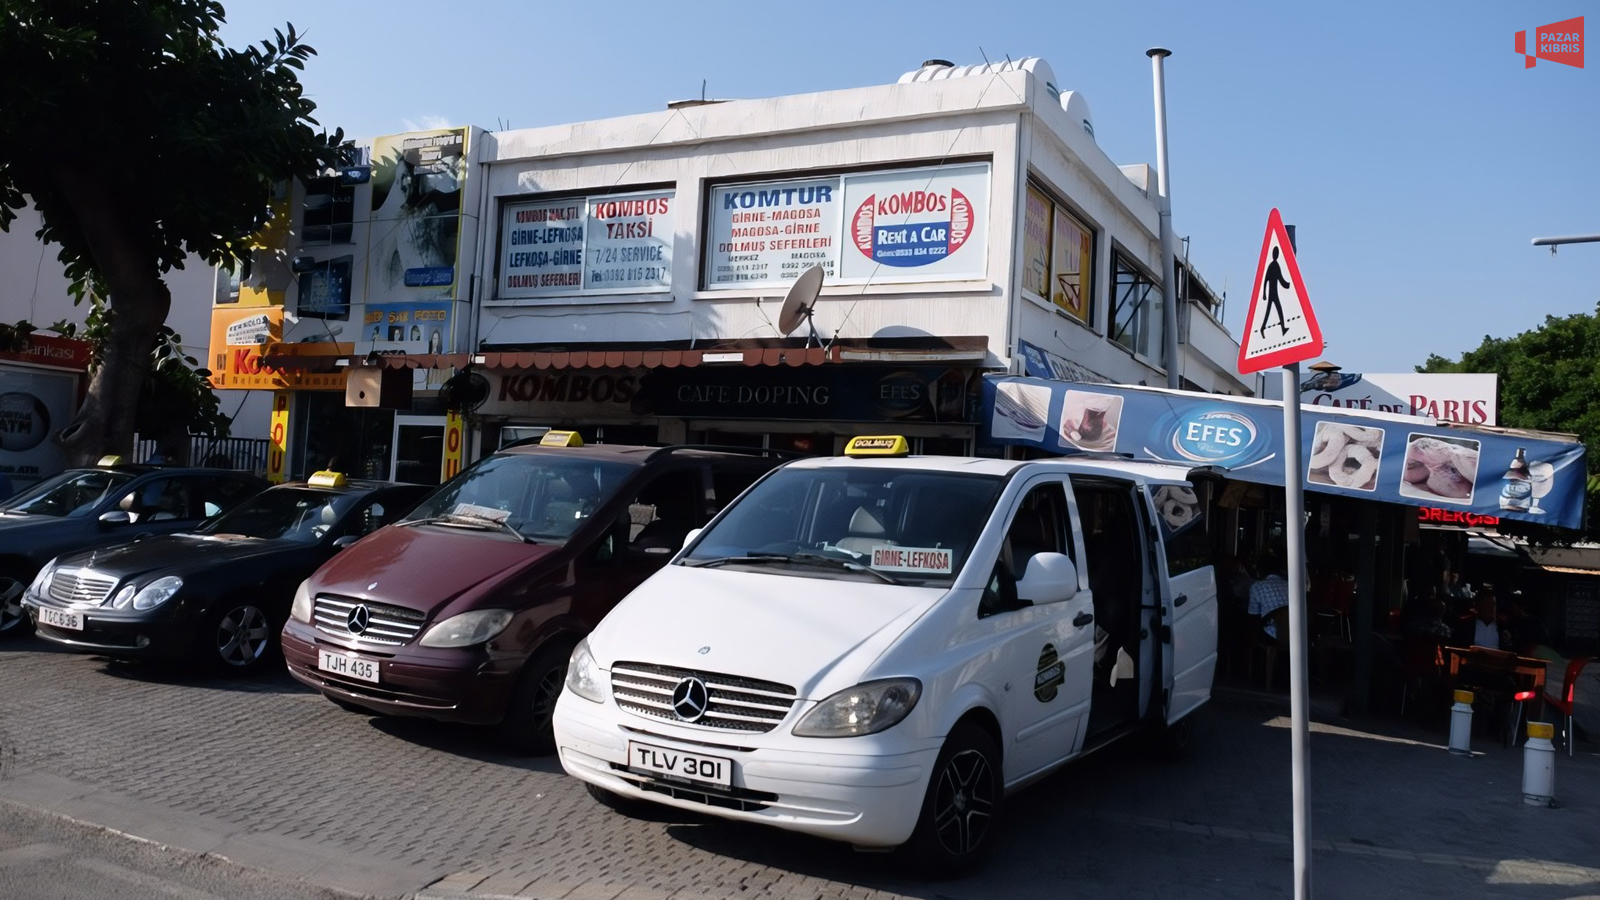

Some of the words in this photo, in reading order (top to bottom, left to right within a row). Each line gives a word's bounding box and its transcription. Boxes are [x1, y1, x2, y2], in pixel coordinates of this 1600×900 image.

[596, 197, 669, 219] KOMBOS
[724, 185, 832, 210] KOMTUR
[878, 190, 947, 216] KOMBOS
[606, 217, 653, 239] TAKSİ
[856, 204, 874, 250] KOMBOS
[951, 197, 969, 244] KOMBOS
[511, 226, 584, 246] GİRNE-LEFKOŞA
[909, 230, 918, 243] A
[509, 247, 582, 268] LEFKOŞA-GİRNE
[595, 247, 617, 264] 7/24
[621, 245, 663, 263] SERVICE
[499, 374, 637, 403] KOMBOS
[677, 384, 730, 402] CAFE
[737, 384, 830, 405] DOPING
[880, 383, 920, 400] EFES
[1409, 394, 1488, 426] PARIS
[1185, 421, 1243, 447] EFES
[325, 653, 347, 673] TJH
[350, 660, 373, 679] 435
[637, 747, 678, 770] TLV
[683, 757, 721, 780] 301
